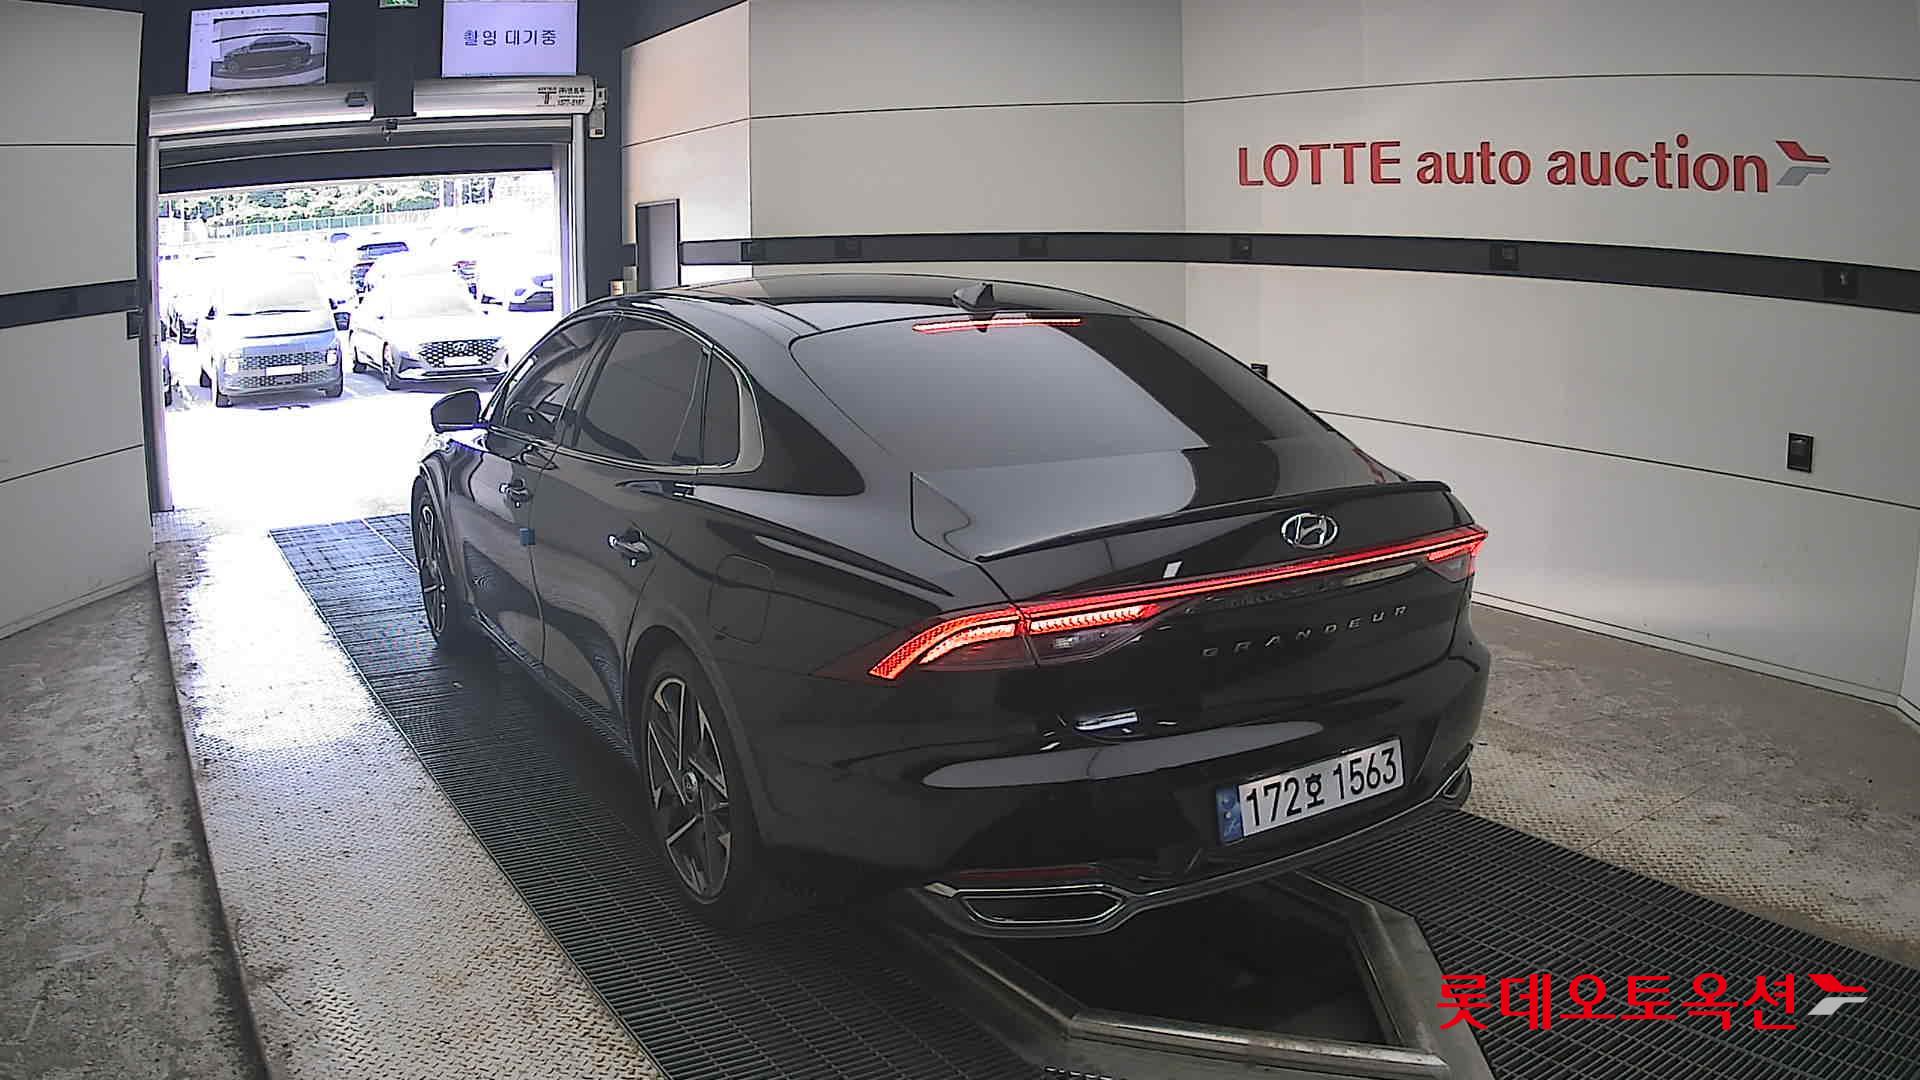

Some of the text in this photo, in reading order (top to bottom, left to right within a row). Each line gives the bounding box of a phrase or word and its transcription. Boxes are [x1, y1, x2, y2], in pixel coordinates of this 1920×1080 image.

[505, 29, 557, 46] 대기중
[1238, 134, 1769, 193] LOTTE auto auction
[1202, 605, 1408, 657] GRANDEUR
[1246, 746, 1397, 828] 172호 1563
